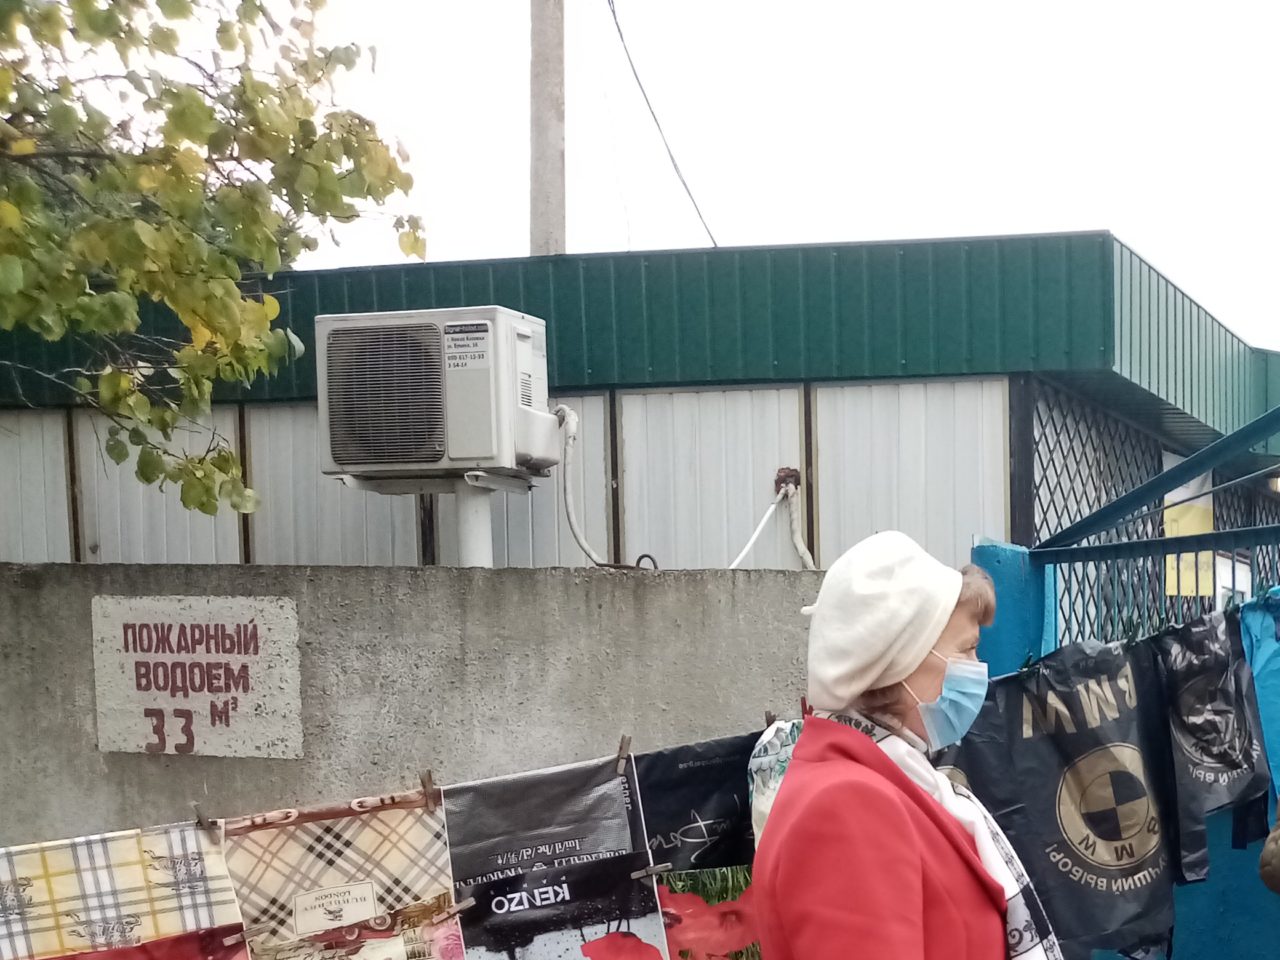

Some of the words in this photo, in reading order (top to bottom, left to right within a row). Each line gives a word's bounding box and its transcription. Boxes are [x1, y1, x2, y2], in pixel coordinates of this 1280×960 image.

[122, 618, 259, 656] ПОЖАРНЫЙ
[134, 661, 250, 698] ВОДОЕМ
[144, 708, 195, 754] 33
[1044, 843, 1107, 891] ВЫБОР!
[1111, 855, 1169, 895] УЧШИЙ
[315, 890, 351, 901] LONDON
[491, 883, 571, 914] KENZO
